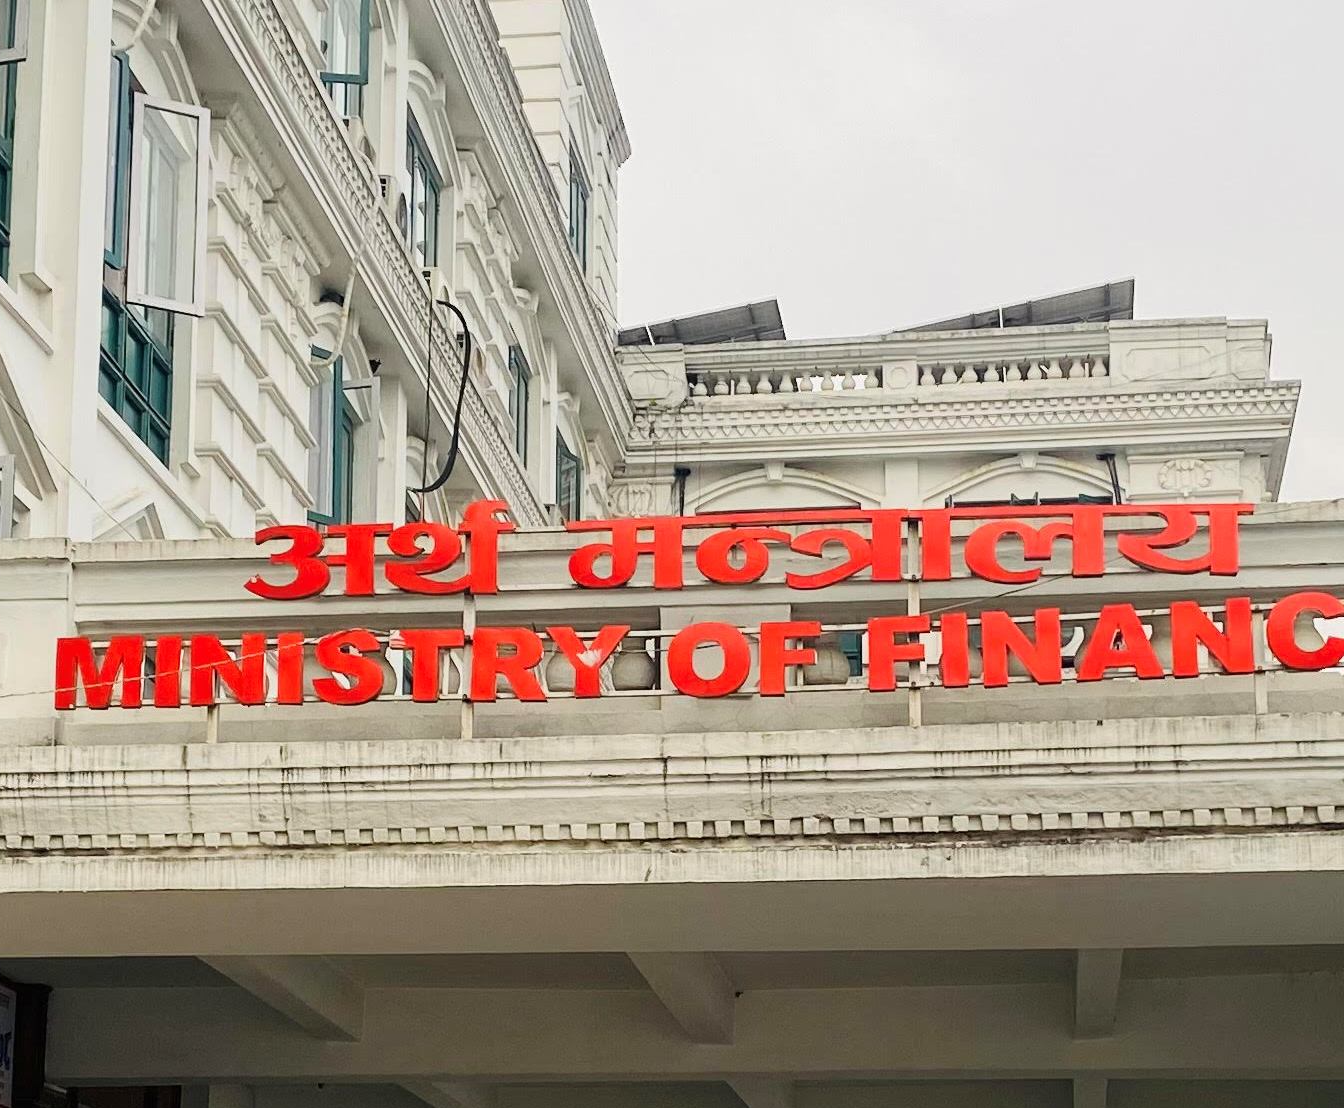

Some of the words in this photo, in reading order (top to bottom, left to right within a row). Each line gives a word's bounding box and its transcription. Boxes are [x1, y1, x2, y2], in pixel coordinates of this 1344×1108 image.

[244, 499, 513, 598] अर्थ
[568, 504, 1253, 588] मन्त्रालय
[55, 625, 627, 708] MINISTRY
[667, 621, 822, 697] OF
